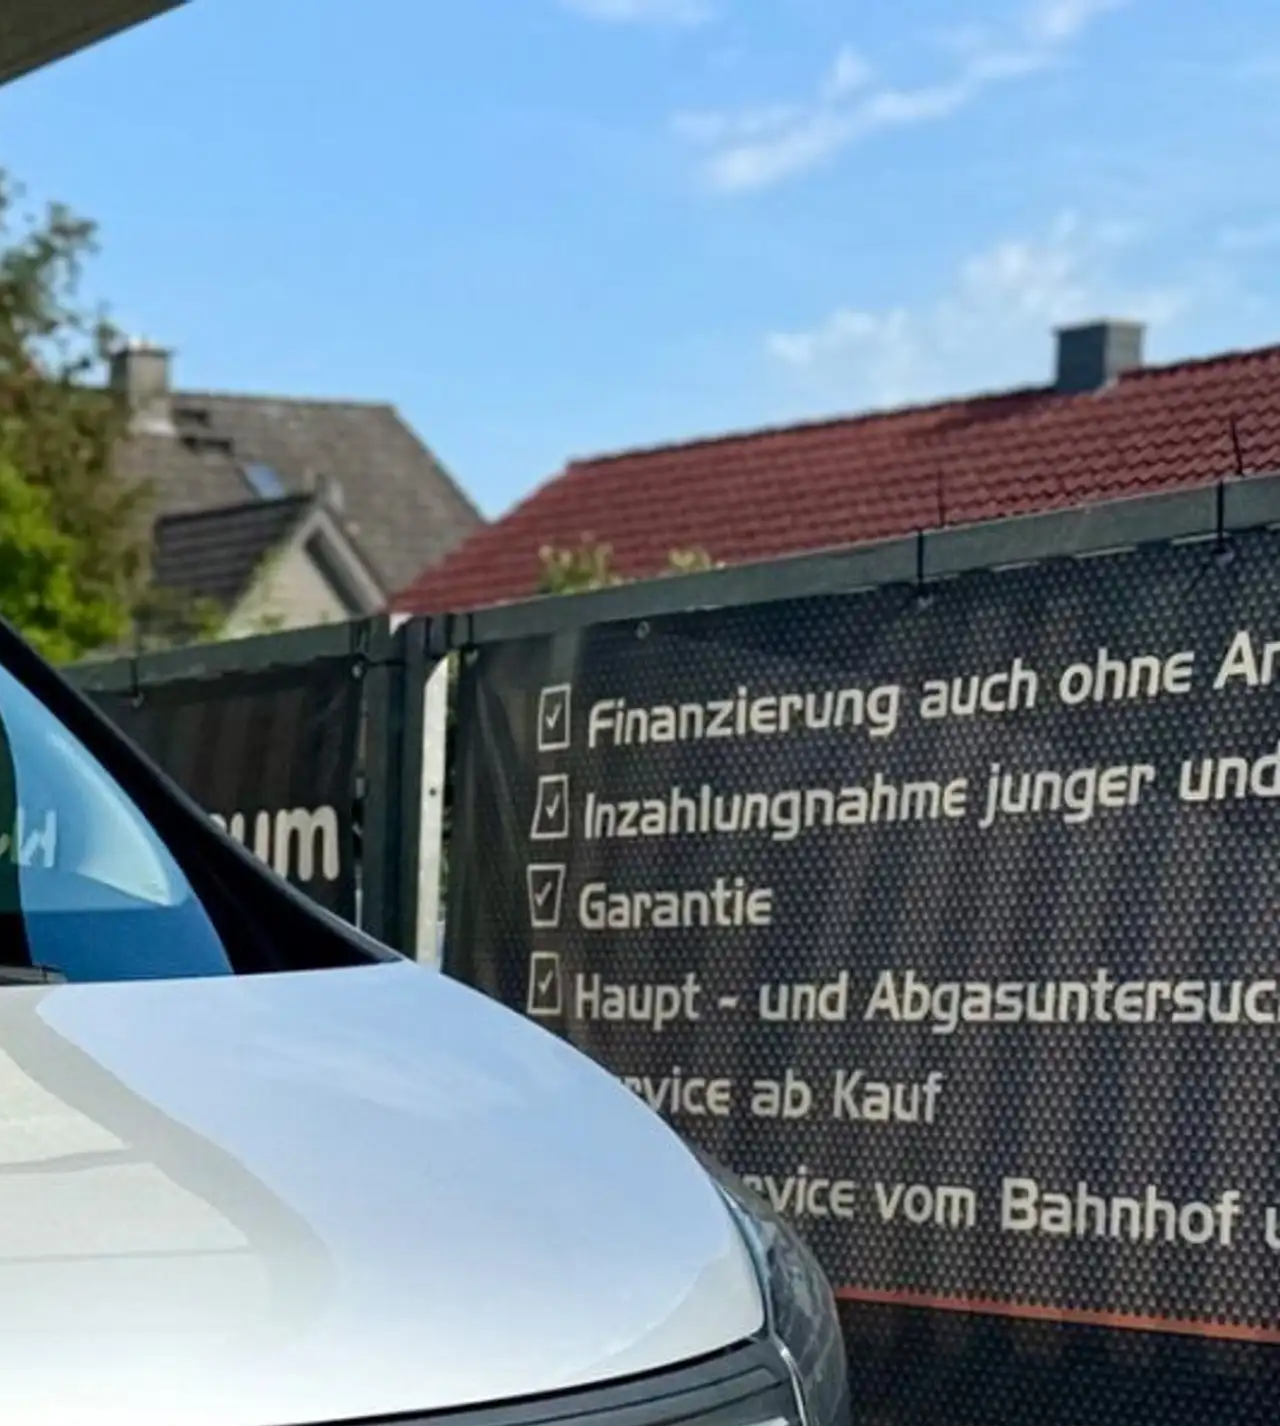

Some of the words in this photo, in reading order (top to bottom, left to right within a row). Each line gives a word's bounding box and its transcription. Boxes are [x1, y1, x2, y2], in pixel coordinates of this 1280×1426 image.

[588, 682, 900, 748] Finanzierung
[919, 658, 1037, 718] auch
[1059, 647, 1195, 704] ohne
[583, 772, 967, 840] Inzahlungnahme
[979, 763, 1155, 828] junger
[1180, 740, 1280, 801] und
[578, 879, 773, 930] Garantie
[575, 973, 701, 1031] Haupt
[759, 970, 847, 1021] und
[864, 967, 1280, 1034] Abgasuntersuc
[751, 1068, 814, 1118] ab
[832, 1068, 945, 1125] Kauf
[874, 1181, 976, 1230] vom
[1000, 1177, 1242, 1247] Bahnhof
